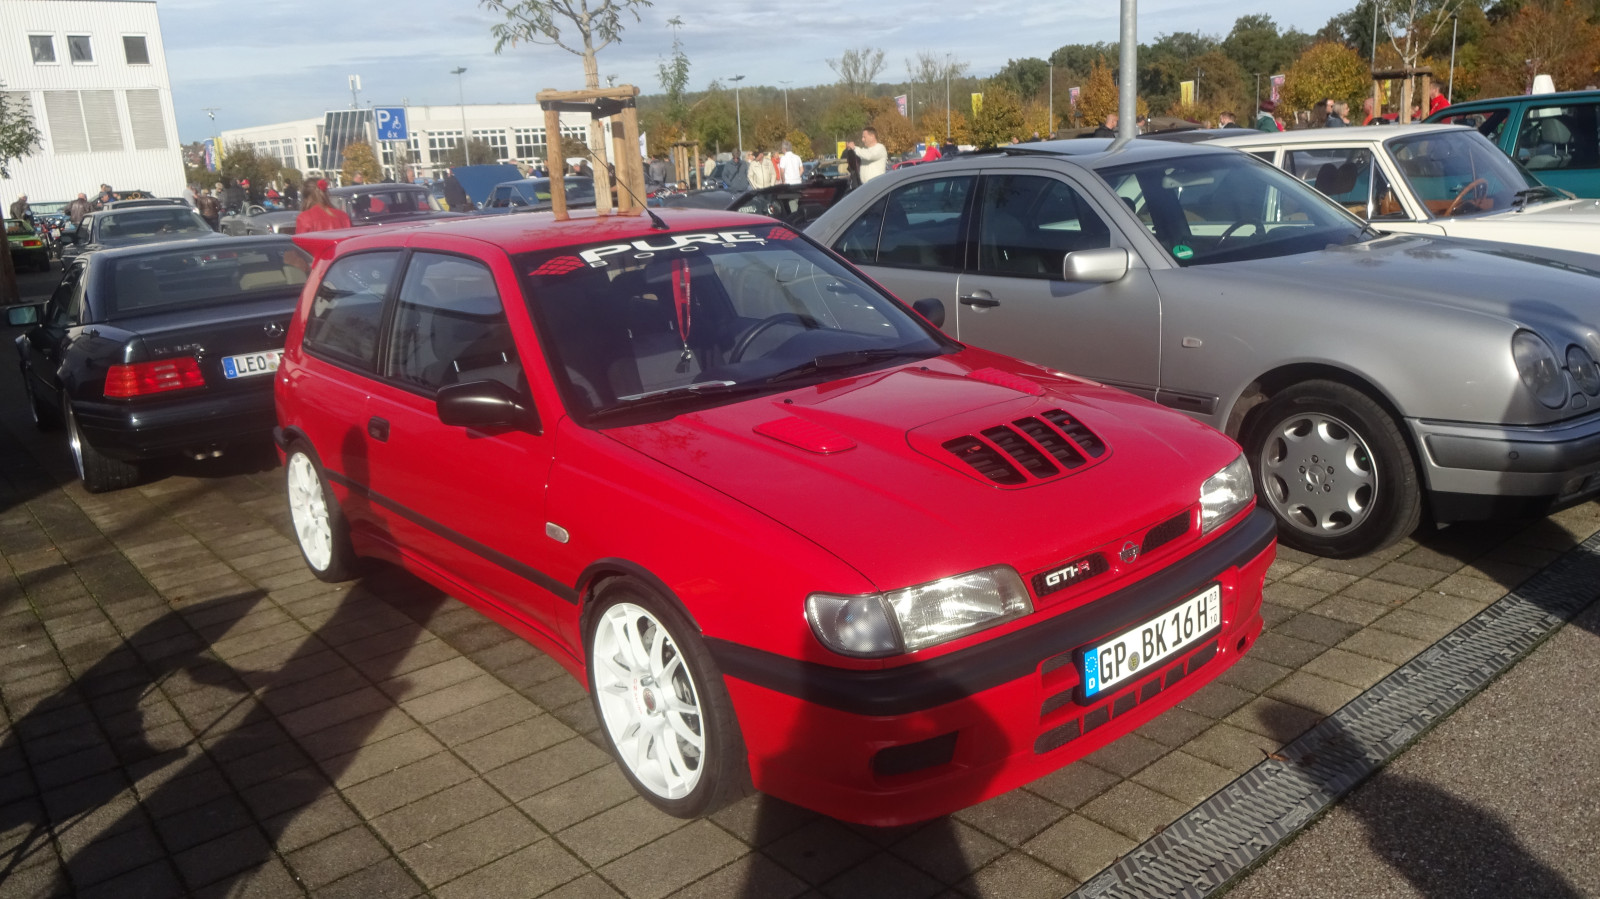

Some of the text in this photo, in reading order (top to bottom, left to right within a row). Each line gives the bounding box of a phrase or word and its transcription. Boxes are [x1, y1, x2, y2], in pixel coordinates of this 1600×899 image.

[377, 110, 390, 129] P
[579, 231, 764, 262] PURE
[589, 239, 768, 268] BOOST
[235, 355, 267, 374] LEO
[1088, 677, 1096, 689] D
[1099, 641, 1126, 684] GP
[1142, 618, 1168, 663] BK
